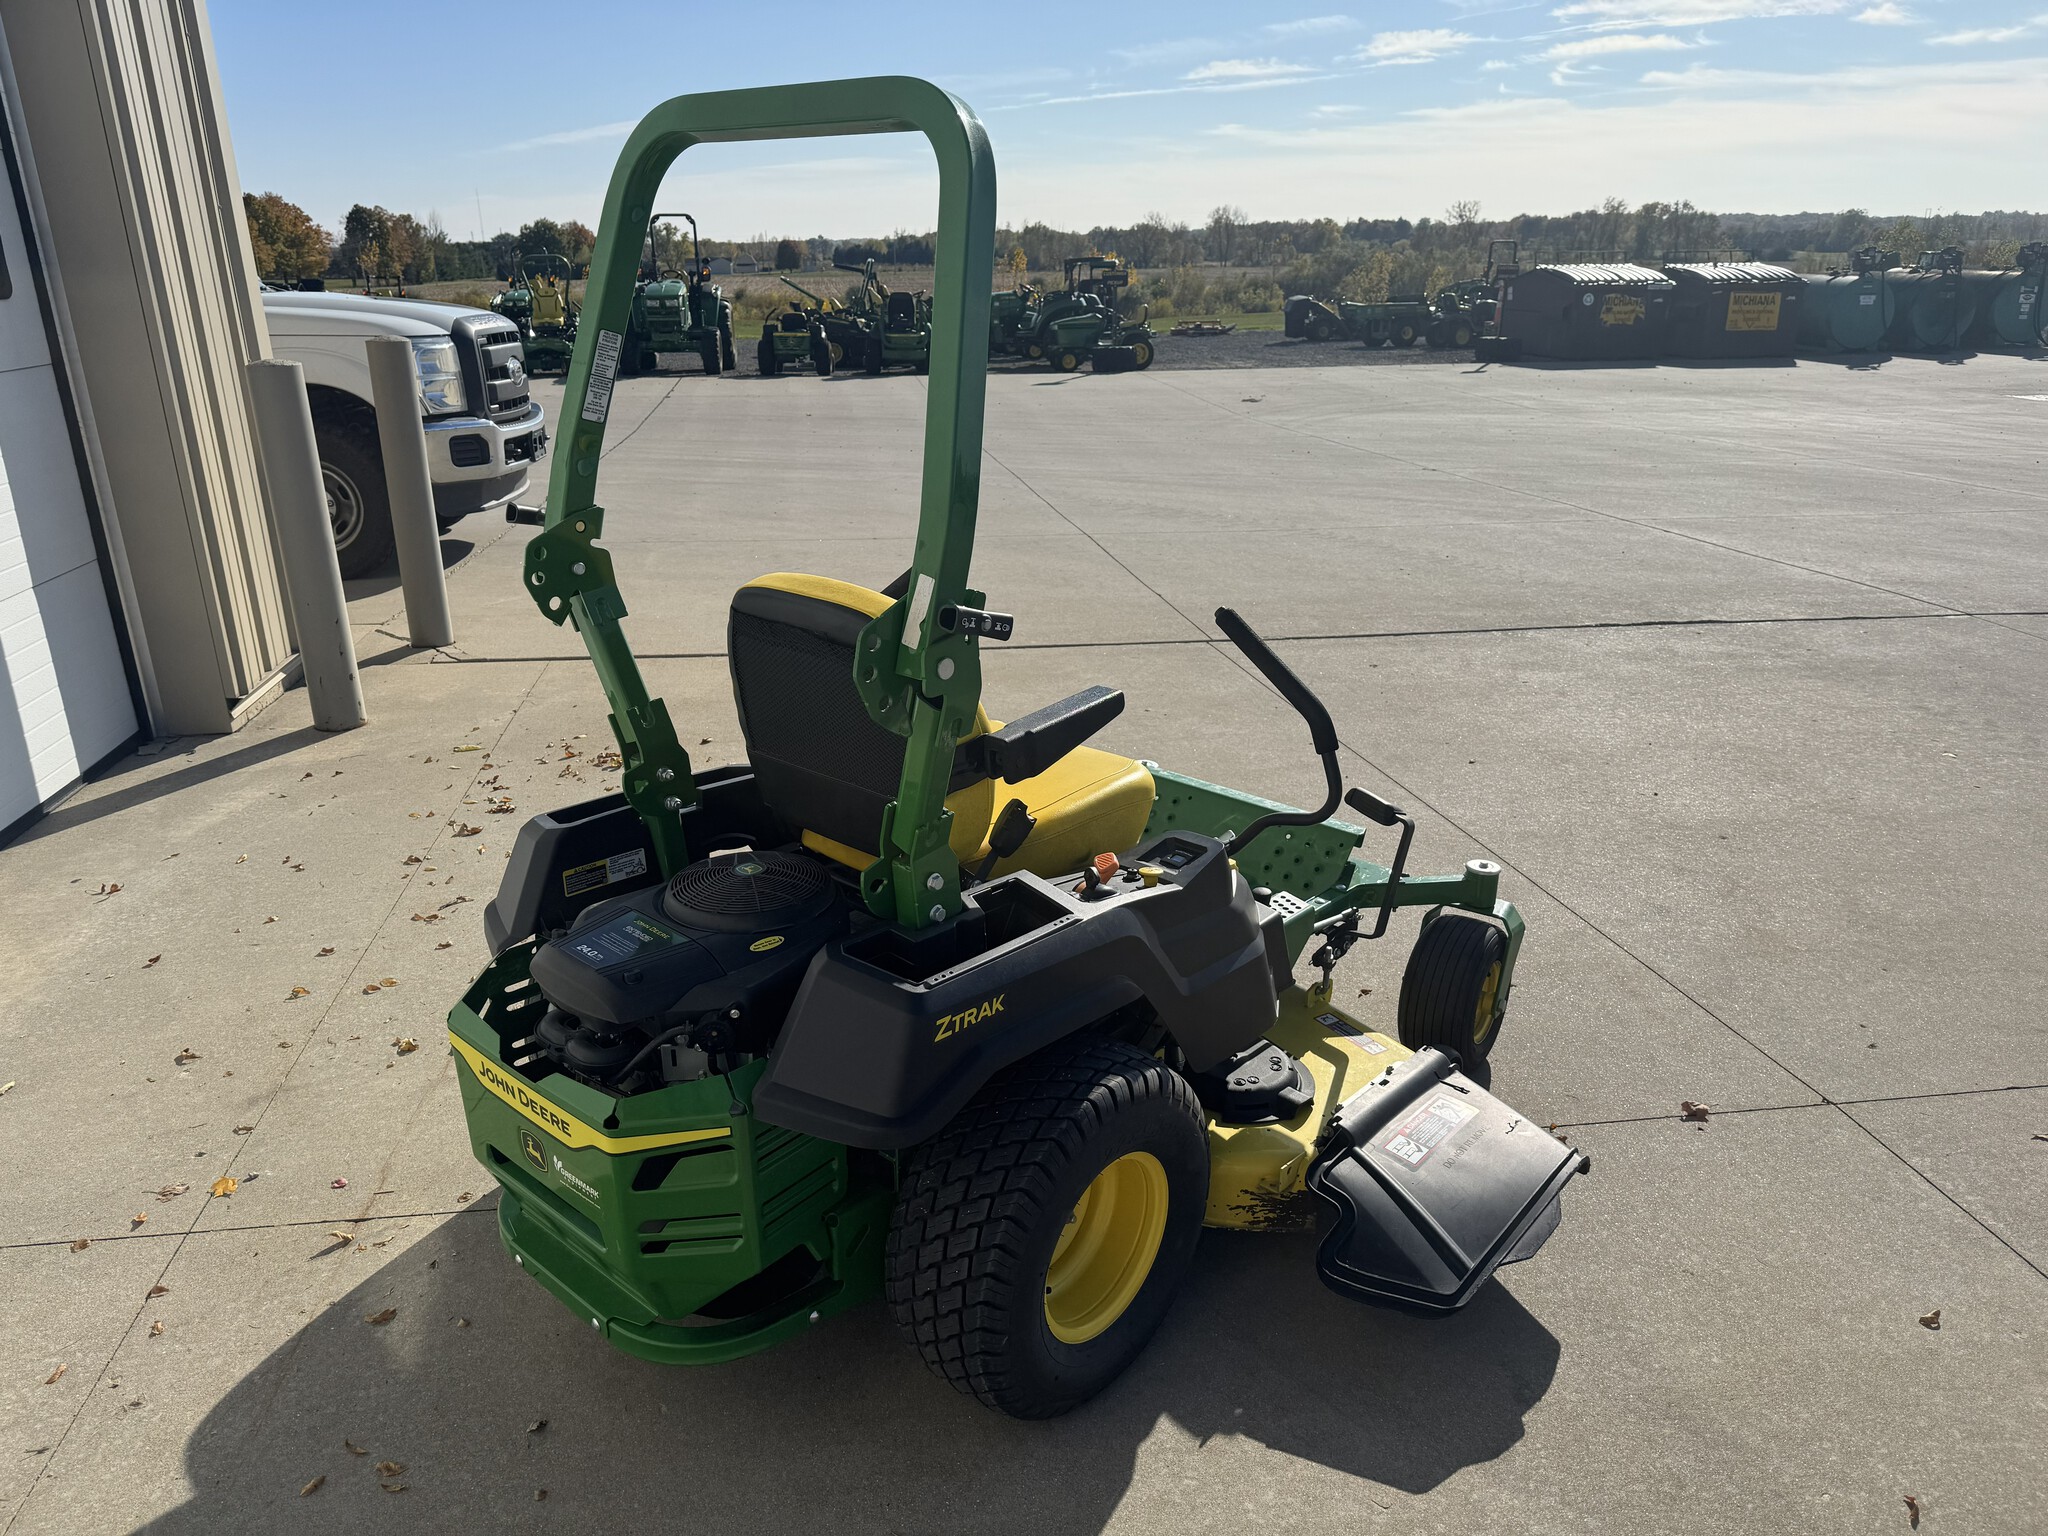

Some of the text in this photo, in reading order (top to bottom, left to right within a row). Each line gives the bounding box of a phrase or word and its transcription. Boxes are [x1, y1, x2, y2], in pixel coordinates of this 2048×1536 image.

[1732, 295, 1776, 306] MICHIANA
[934, 993, 1005, 1043] ZTRAK
[479, 1061, 572, 1138] JOHN DEERE
[1443, 1157, 1456, 1169] DO
